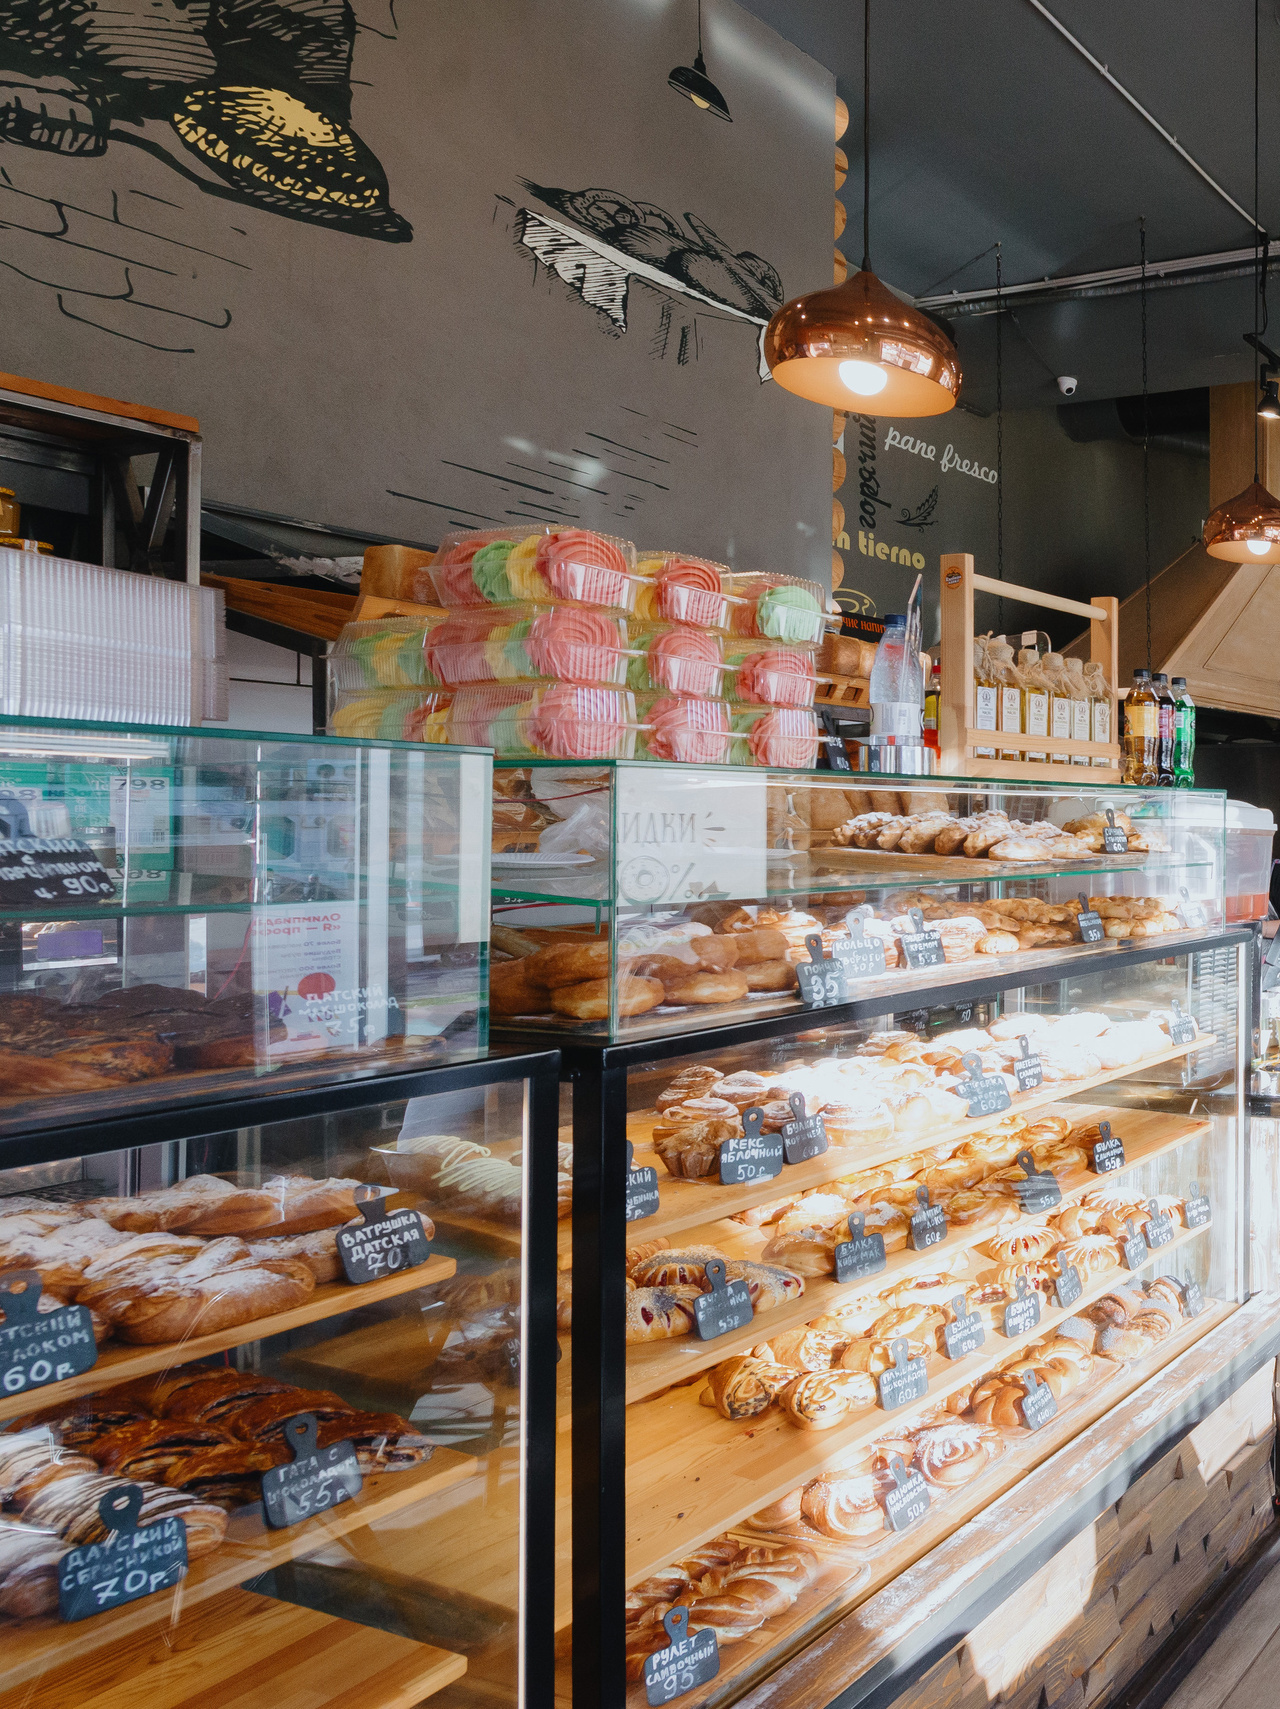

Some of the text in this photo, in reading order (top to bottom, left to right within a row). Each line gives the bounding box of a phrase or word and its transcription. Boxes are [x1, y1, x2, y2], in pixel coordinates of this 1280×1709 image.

[884, 426, 998, 484] pane fresco
[858, 530, 926, 570] tierno
[617, 811, 697, 847] ИДКИ
[0, 860, 108, 882] АРЦИПАНОМ
[835, 939, 881, 951] КОЛЬЦО
[803, 960, 843, 975] ПОНЧИК
[305, 983, 384, 1006] ДАТСКИЙ
[810, 970, 839, 1001] 35
[786, 1119, 815, 1136] БУЛКА
[720, 1144, 784, 1165] ЯБЛОЧНЫЙ
[728, 1137, 765, 1151] КЕКС
[1096, 1138, 1121, 1153] БУЛКА
[626, 1167, 652, 1186] КИЙ
[341, 1212, 418, 1249] ВАТРУШКА
[350, 1228, 420, 1263] ДАТСКАЯ
[840, 1237, 874, 1255] БУЛКА
[1010, 1297, 1036, 1318] БУЛКА
[951, 1314, 976, 1335] БУЛКА
[278, 1455, 319, 1483] ГАТА
[66, 1516, 178, 1572] ДАТСКИЙ
[645, 1639, 715, 1687] СЛИВОЧНЫЙ
[652, 1635, 699, 1671] РУЛЕТ
